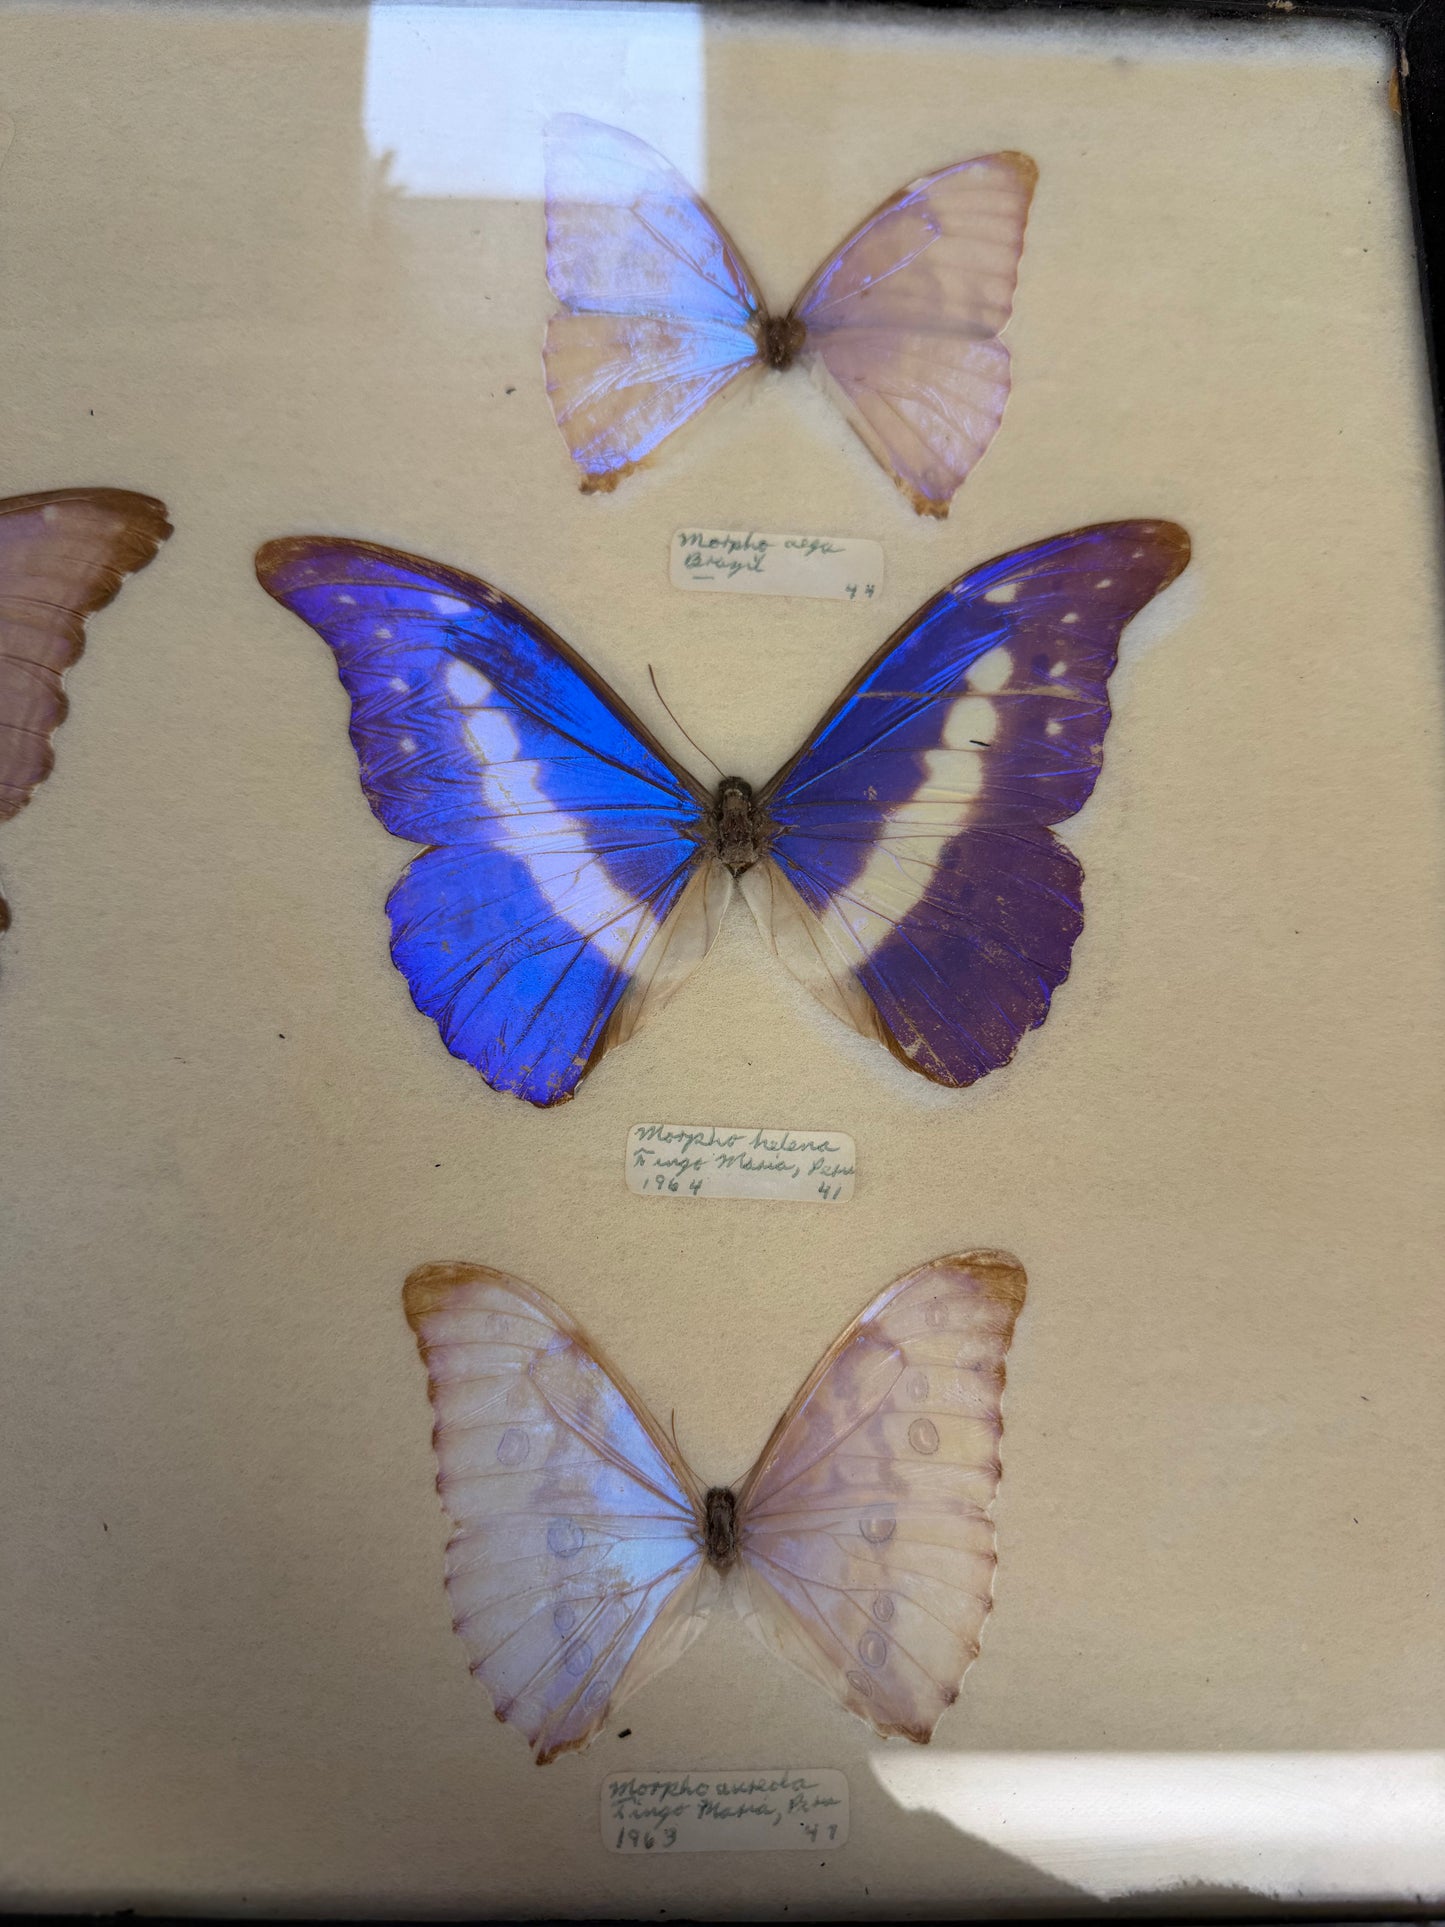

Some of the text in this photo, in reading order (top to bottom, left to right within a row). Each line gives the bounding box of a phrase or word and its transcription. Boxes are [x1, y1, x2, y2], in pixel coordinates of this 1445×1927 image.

[678, 531, 776, 554] Morpho
[634, 1124, 840, 1153] Morpho helena
[642, 1174, 703, 1195] 1964
[817, 1180, 842, 1200] 41
[609, 1775, 709, 1802] Morpho
[616, 1826, 677, 1849] 1963
